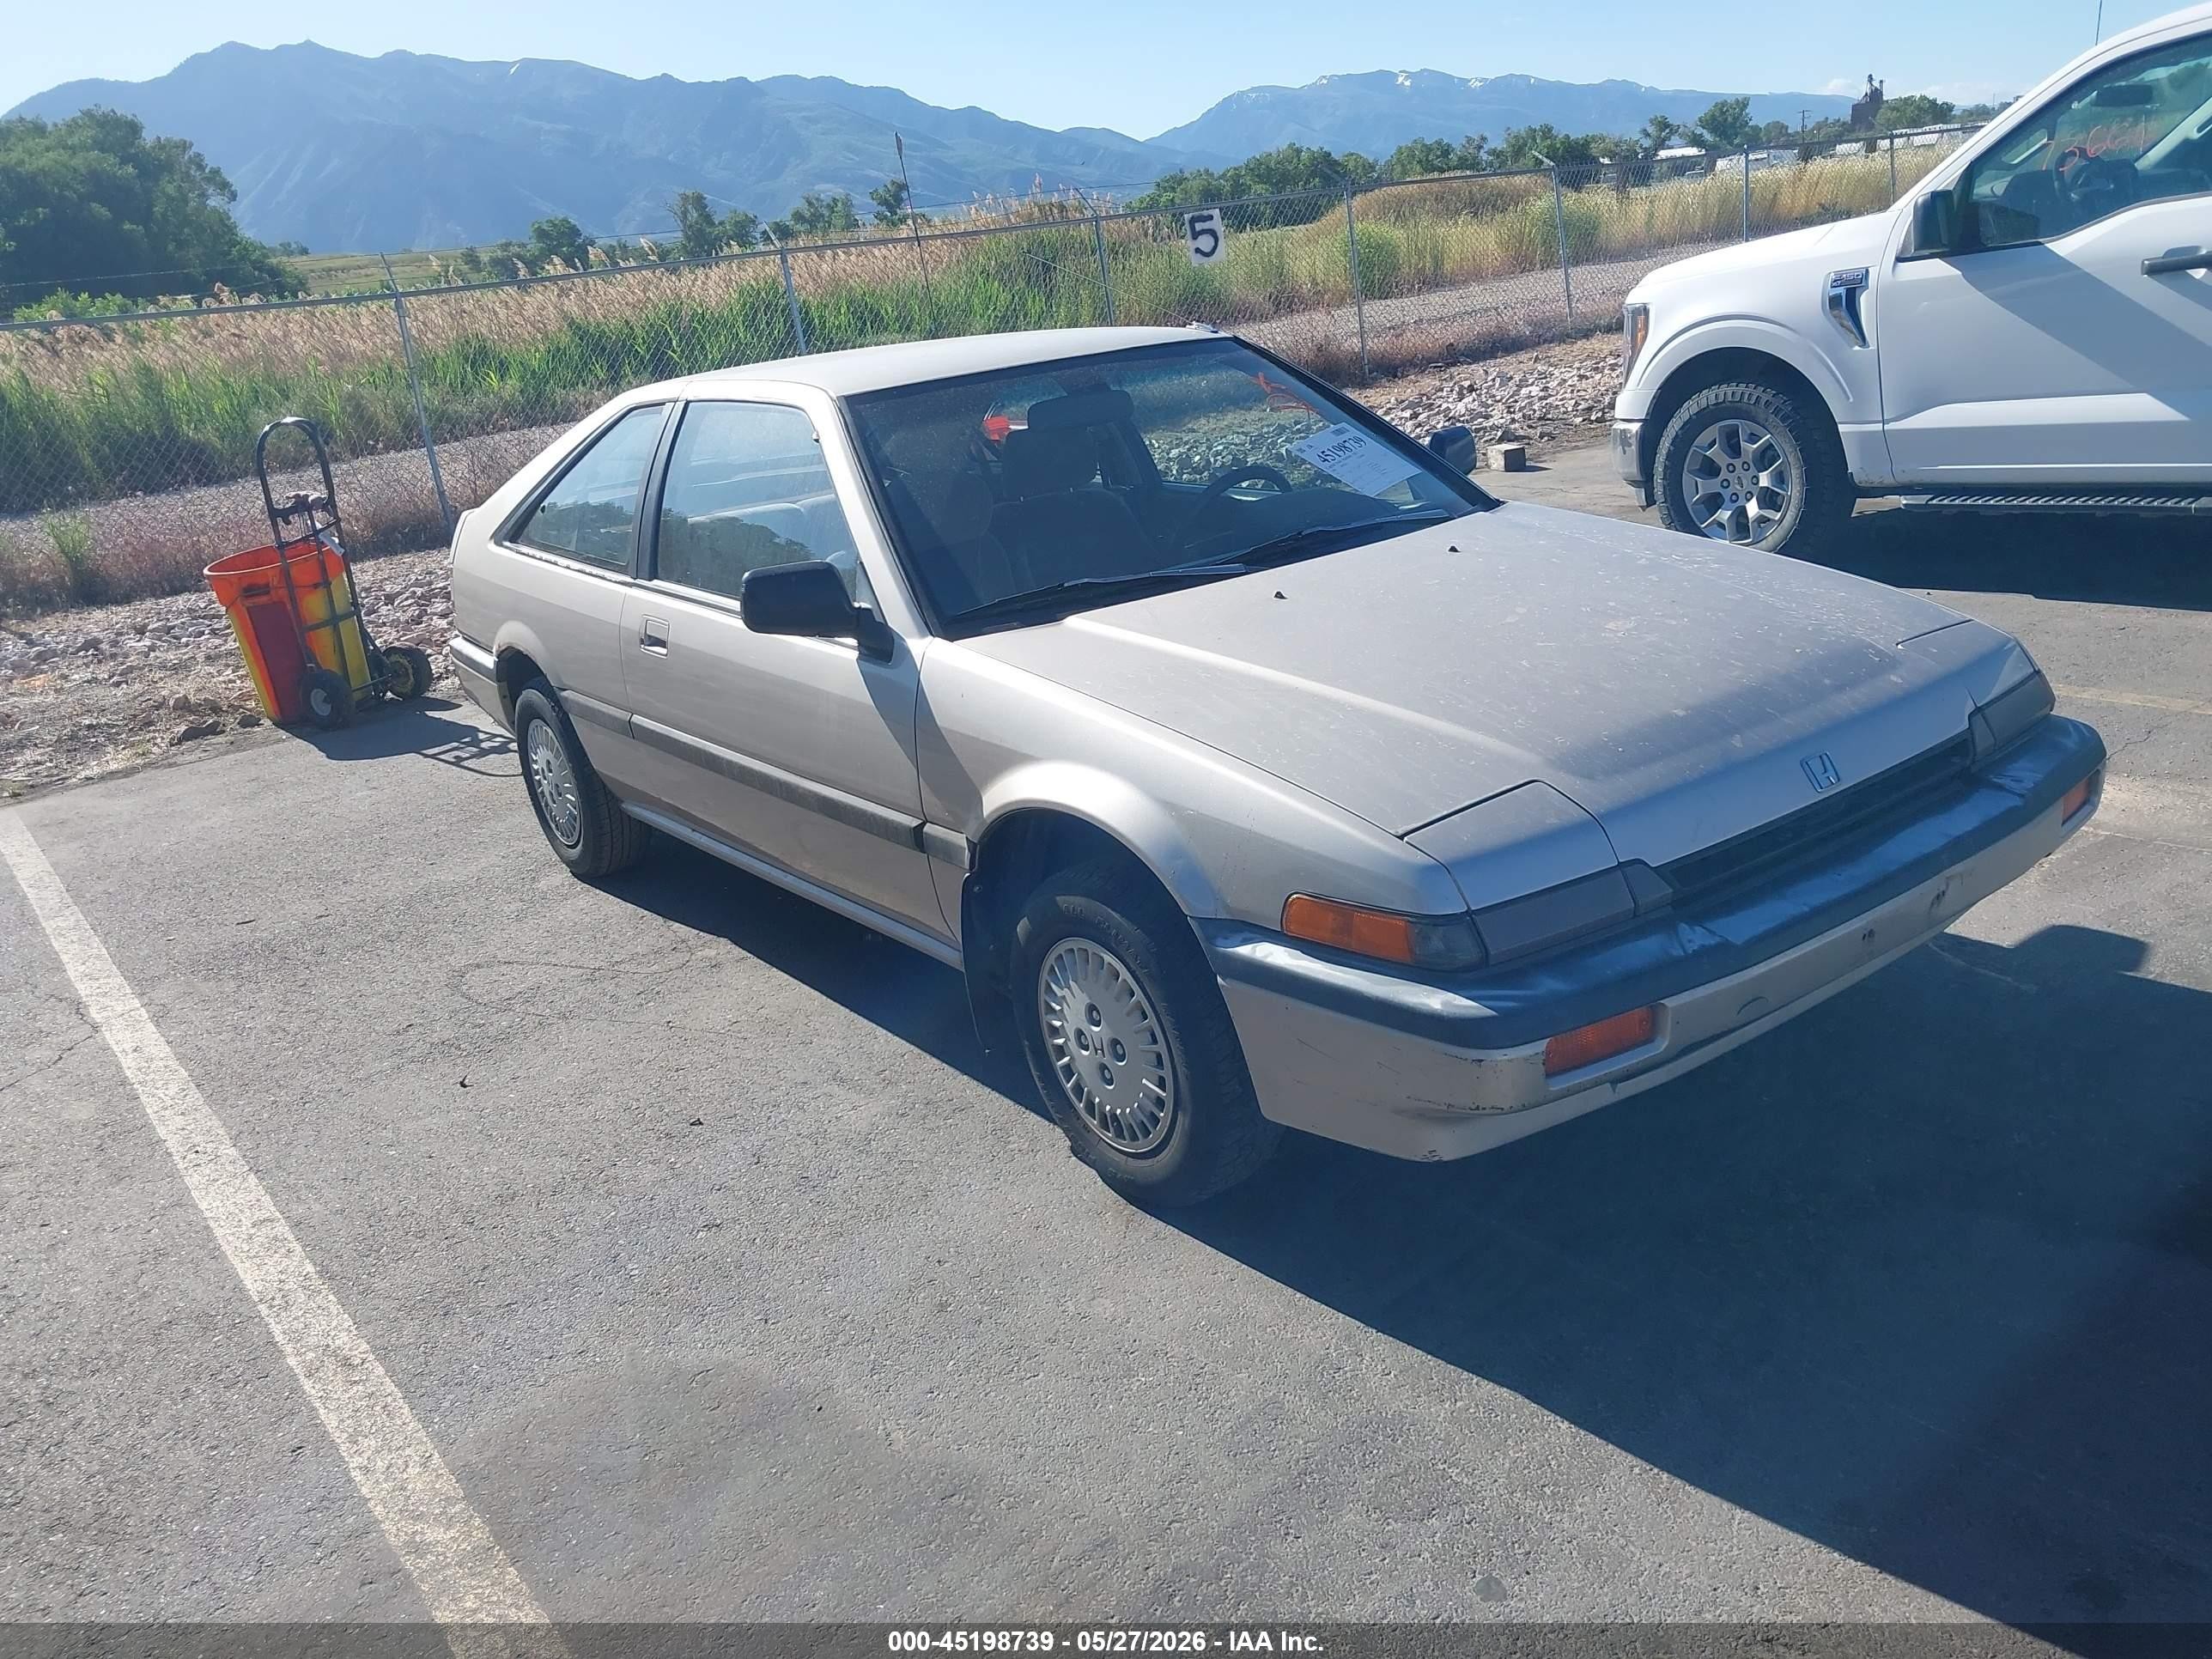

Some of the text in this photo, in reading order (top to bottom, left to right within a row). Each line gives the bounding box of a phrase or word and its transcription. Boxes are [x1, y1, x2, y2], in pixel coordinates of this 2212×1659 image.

[1188, 214, 1218, 258] 5
[1832, 272, 1862, 282] F-150
[1316, 435, 1367, 463] 45198739
